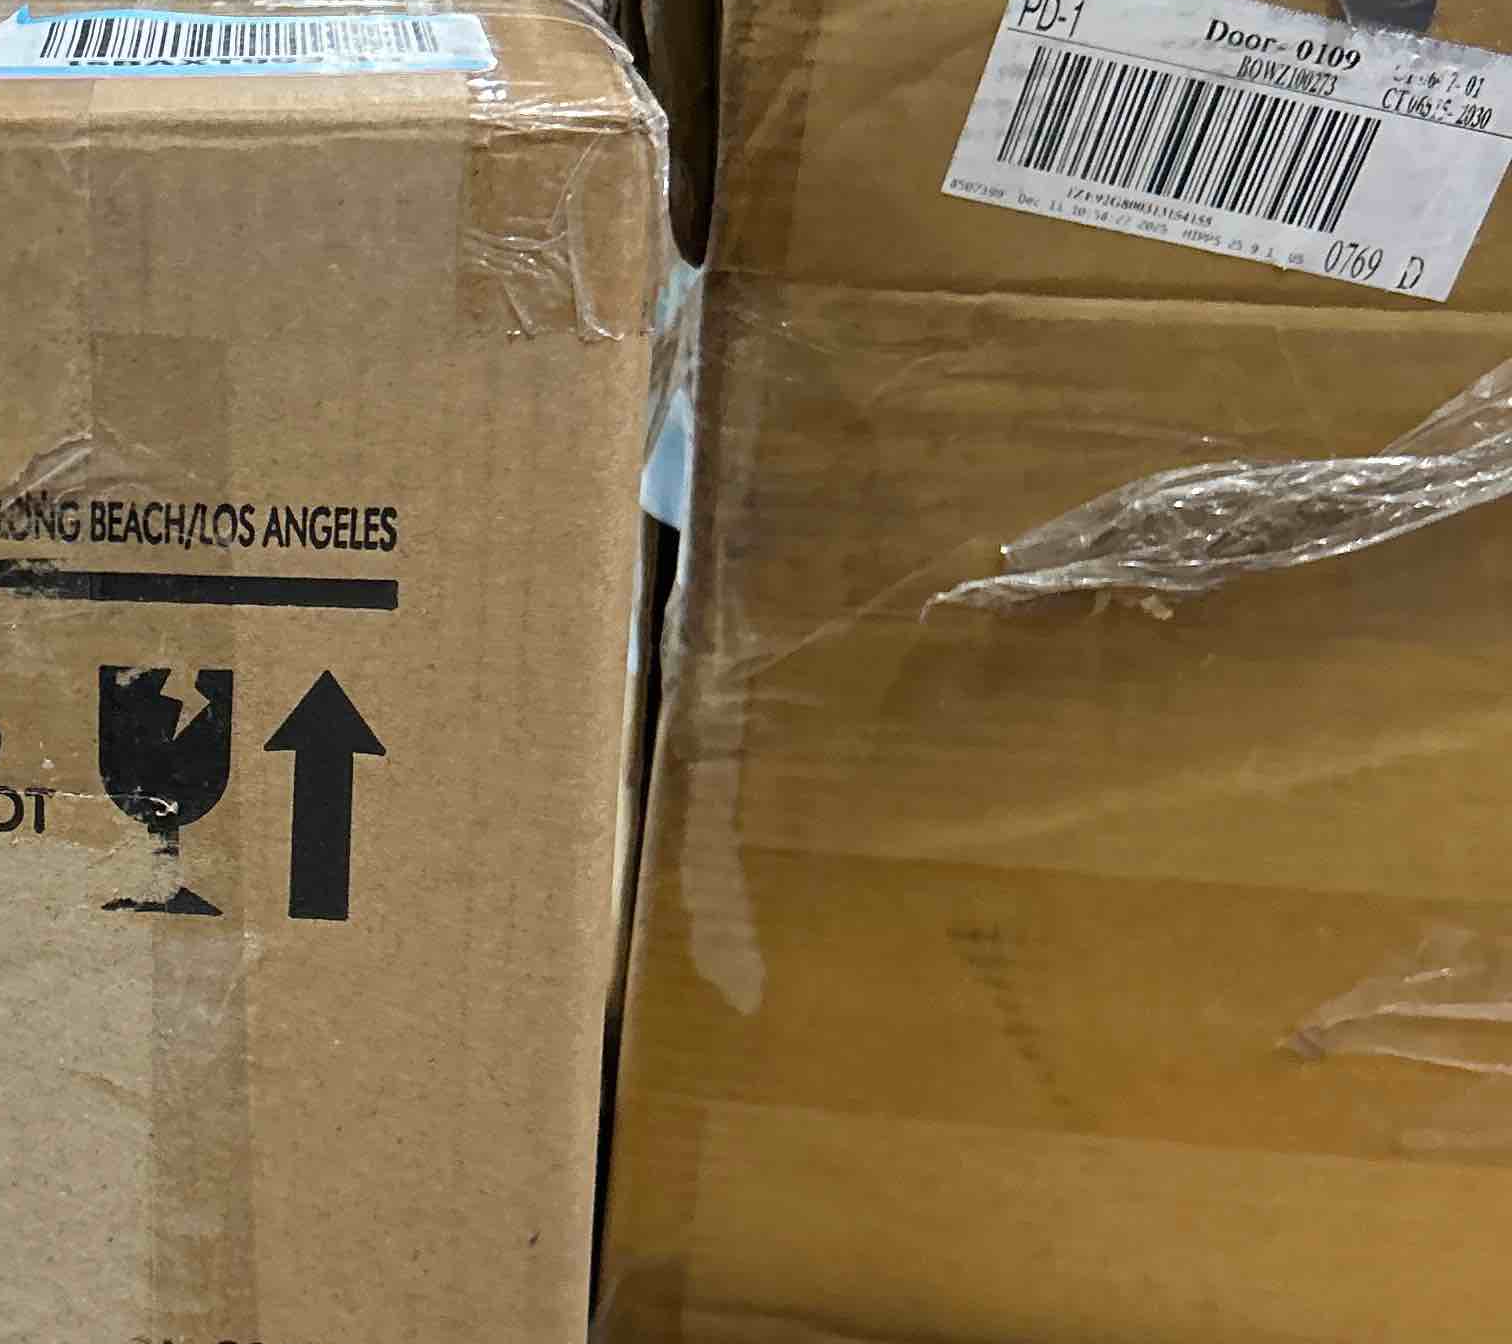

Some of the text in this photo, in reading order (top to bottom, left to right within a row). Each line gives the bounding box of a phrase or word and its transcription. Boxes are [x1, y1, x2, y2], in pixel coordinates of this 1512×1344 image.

[1324, 239, 1426, 290] 0769 D
[88, 500, 257, 550] BEACH/LOS
[261, 504, 399, 553] ANGELES
